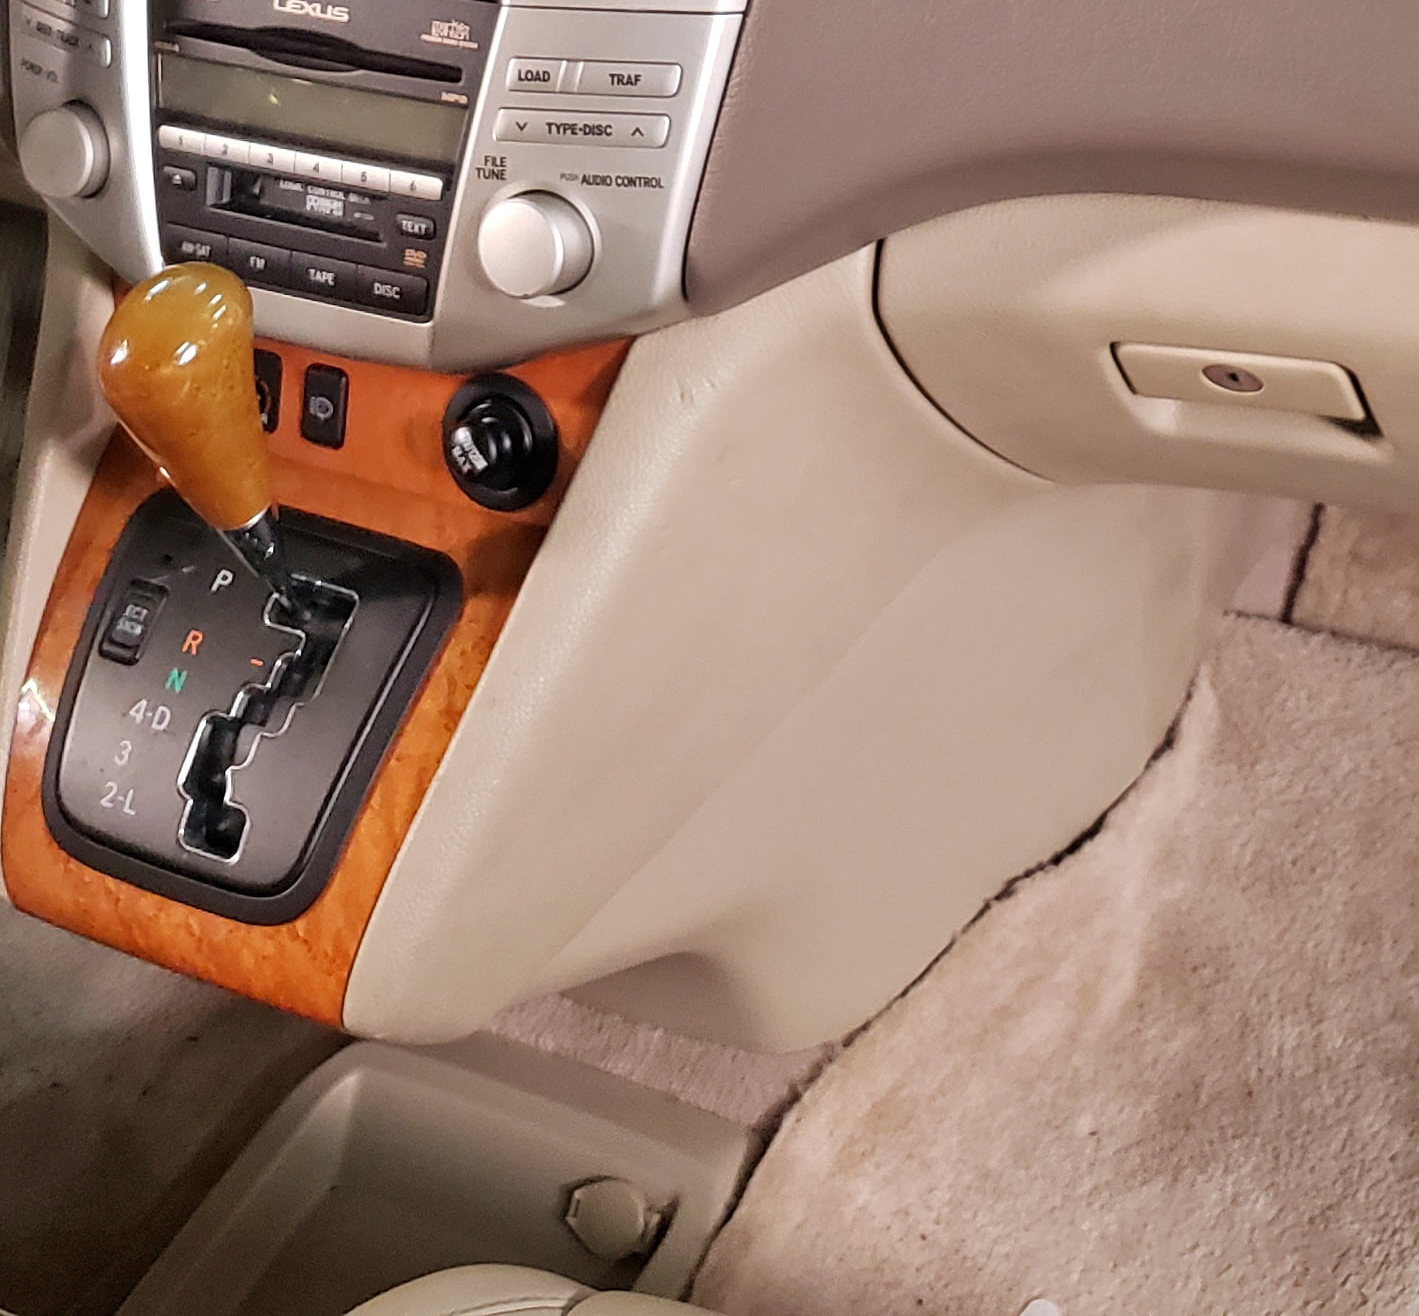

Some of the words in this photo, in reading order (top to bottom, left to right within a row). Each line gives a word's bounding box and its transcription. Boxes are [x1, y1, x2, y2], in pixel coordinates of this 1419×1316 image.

[518, 68, 551, 83] LOAD
[609, 73, 642, 87] TRAF
[222, 144, 229, 155] 2
[267, 153, 274, 165] 3
[312, 161, 320, 173] 4
[484, 155, 507, 168] FILE
[476, 168, 507, 181] TUNE
[581, 175, 613, 187] AUDIO
[615, 175, 664, 189] CONTROL
[401, 219, 428, 236] TEXT
[308, 268, 336, 286] TAPE
[373, 282, 401, 300] DISC
[210, 568, 234, 593] P
[183, 630, 203, 656] R
[165, 667, 189, 693] N
[128, 699, 172, 731] 4-D
[114, 740, 132, 767] 3
[99, 781, 137, 816] 2-L
